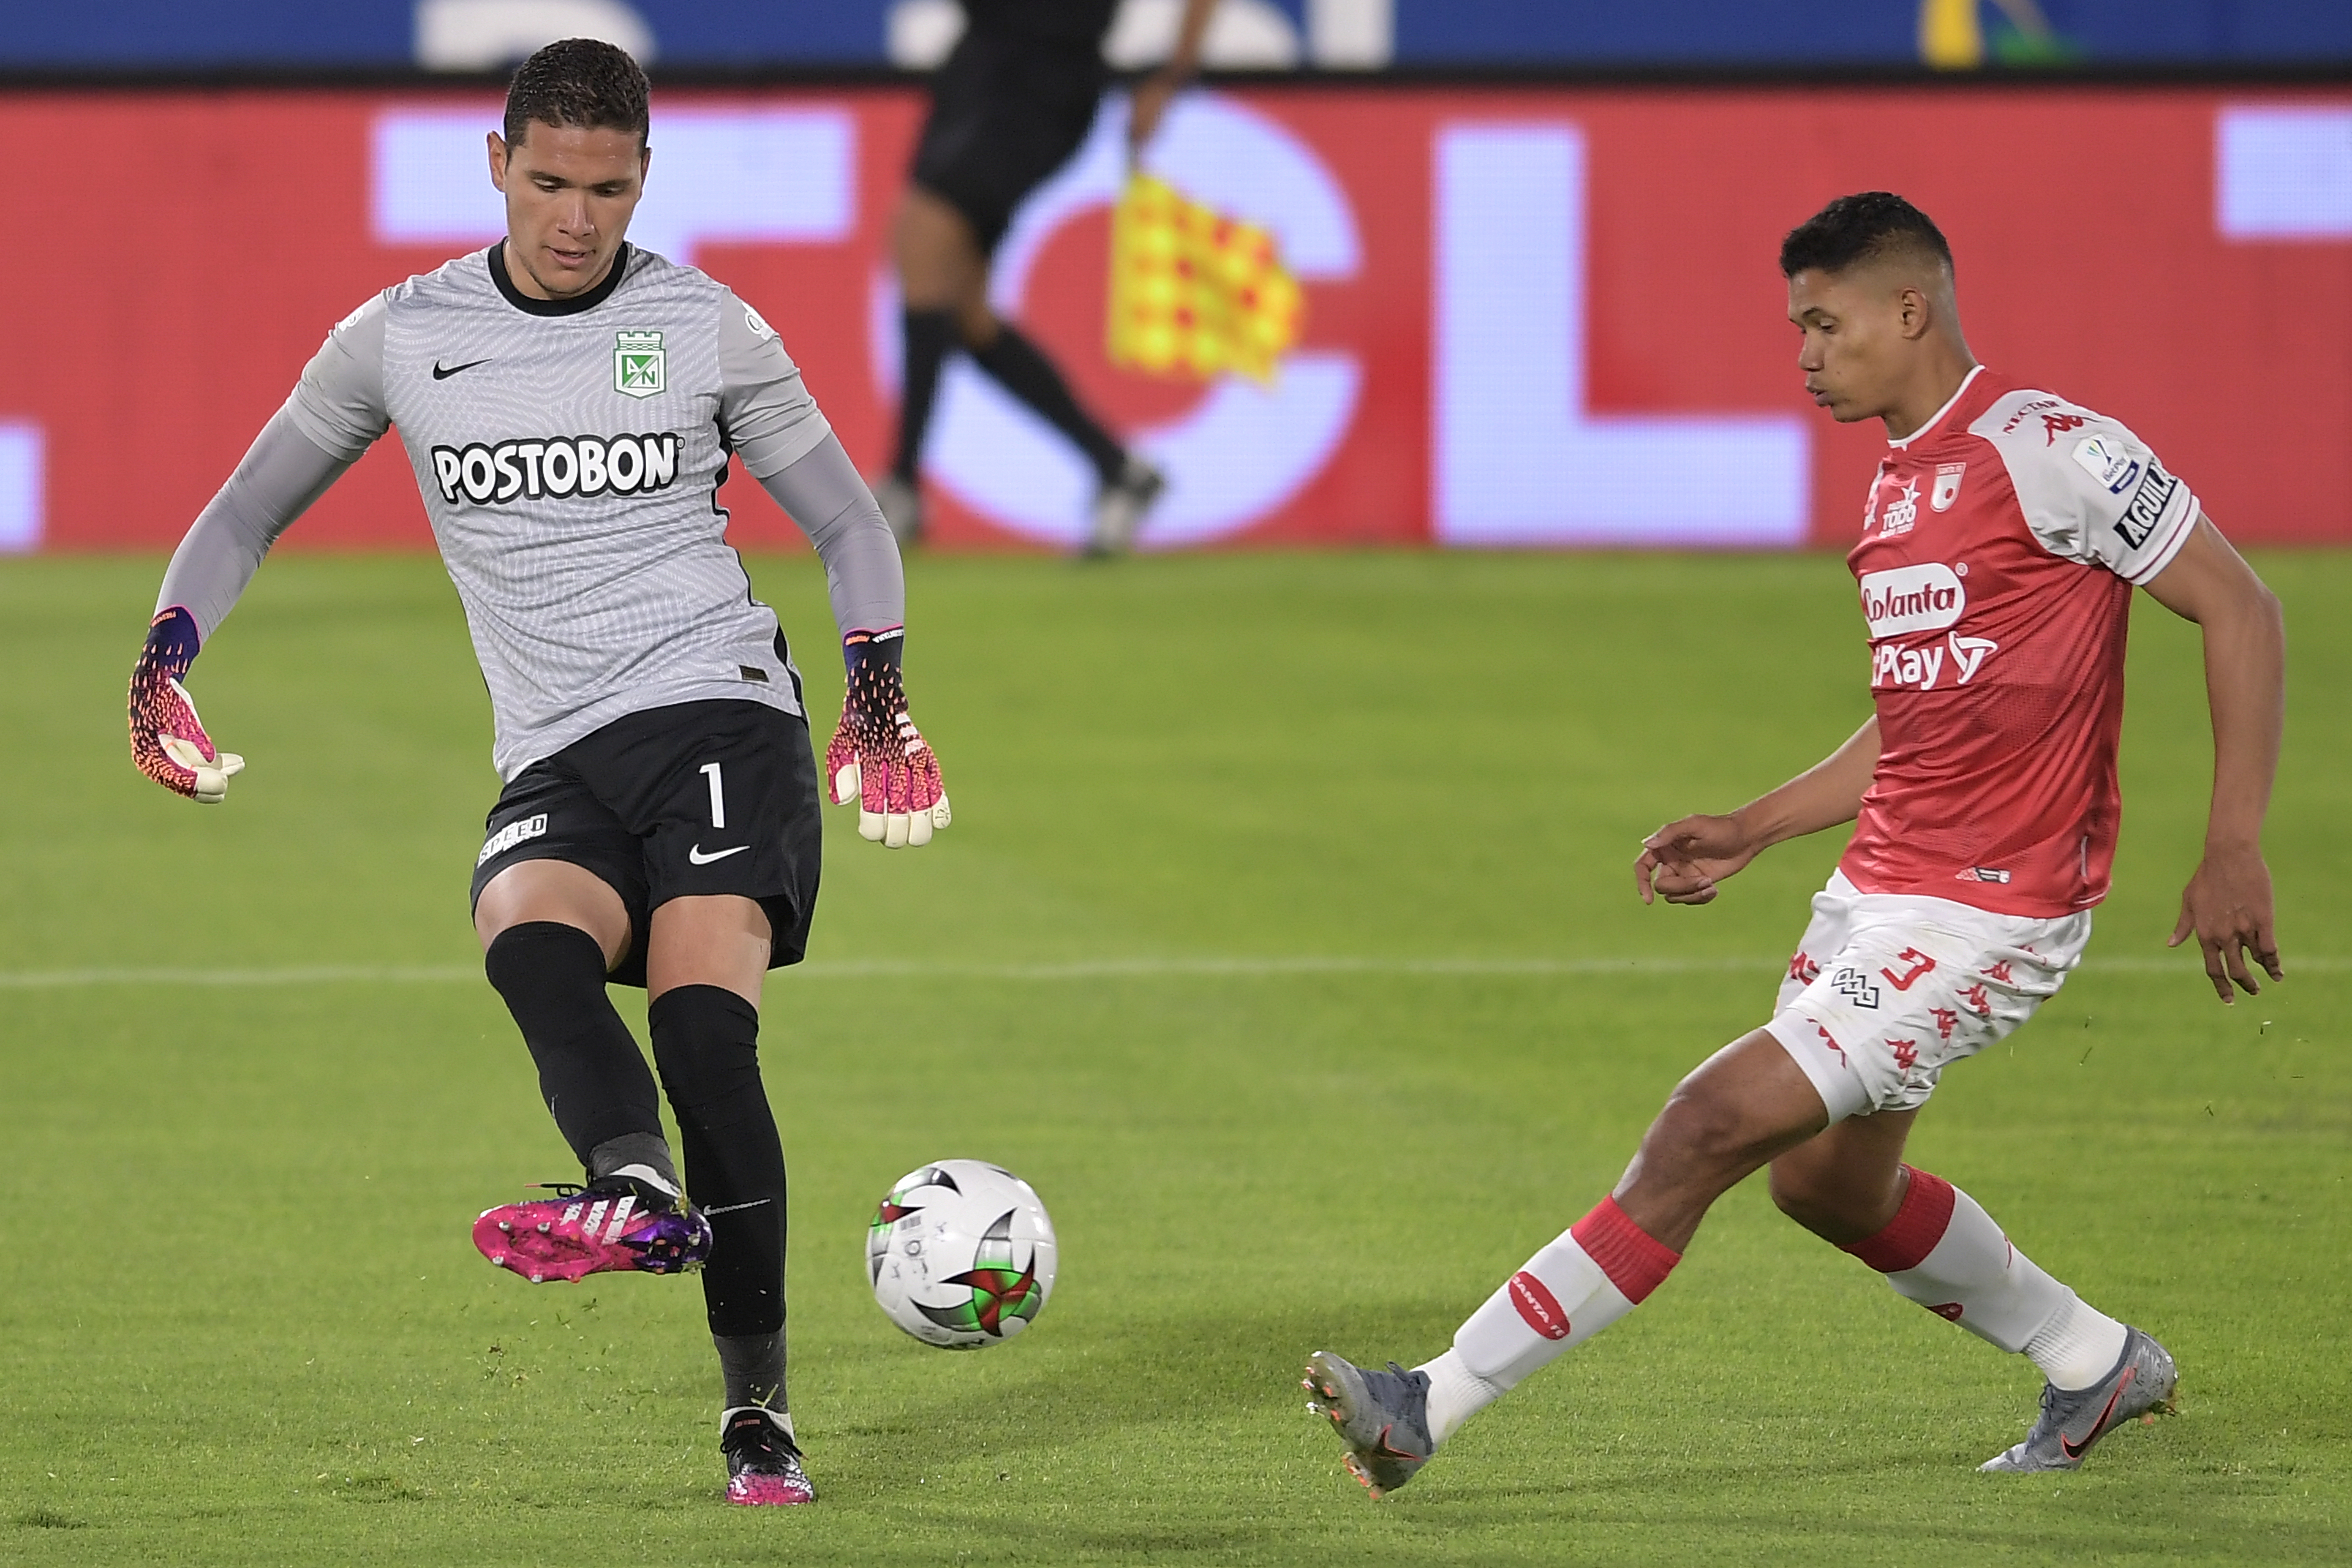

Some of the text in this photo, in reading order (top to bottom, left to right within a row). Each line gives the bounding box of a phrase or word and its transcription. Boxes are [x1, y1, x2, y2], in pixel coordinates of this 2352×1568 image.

[433, 435, 677, 502] POSTOBON
[1864, 583, 1956, 623] Colanta
[700, 763, 724, 828] 1
[480, 817, 545, 863] SPEED
[1511, 1277, 1549, 1323] SANTA
